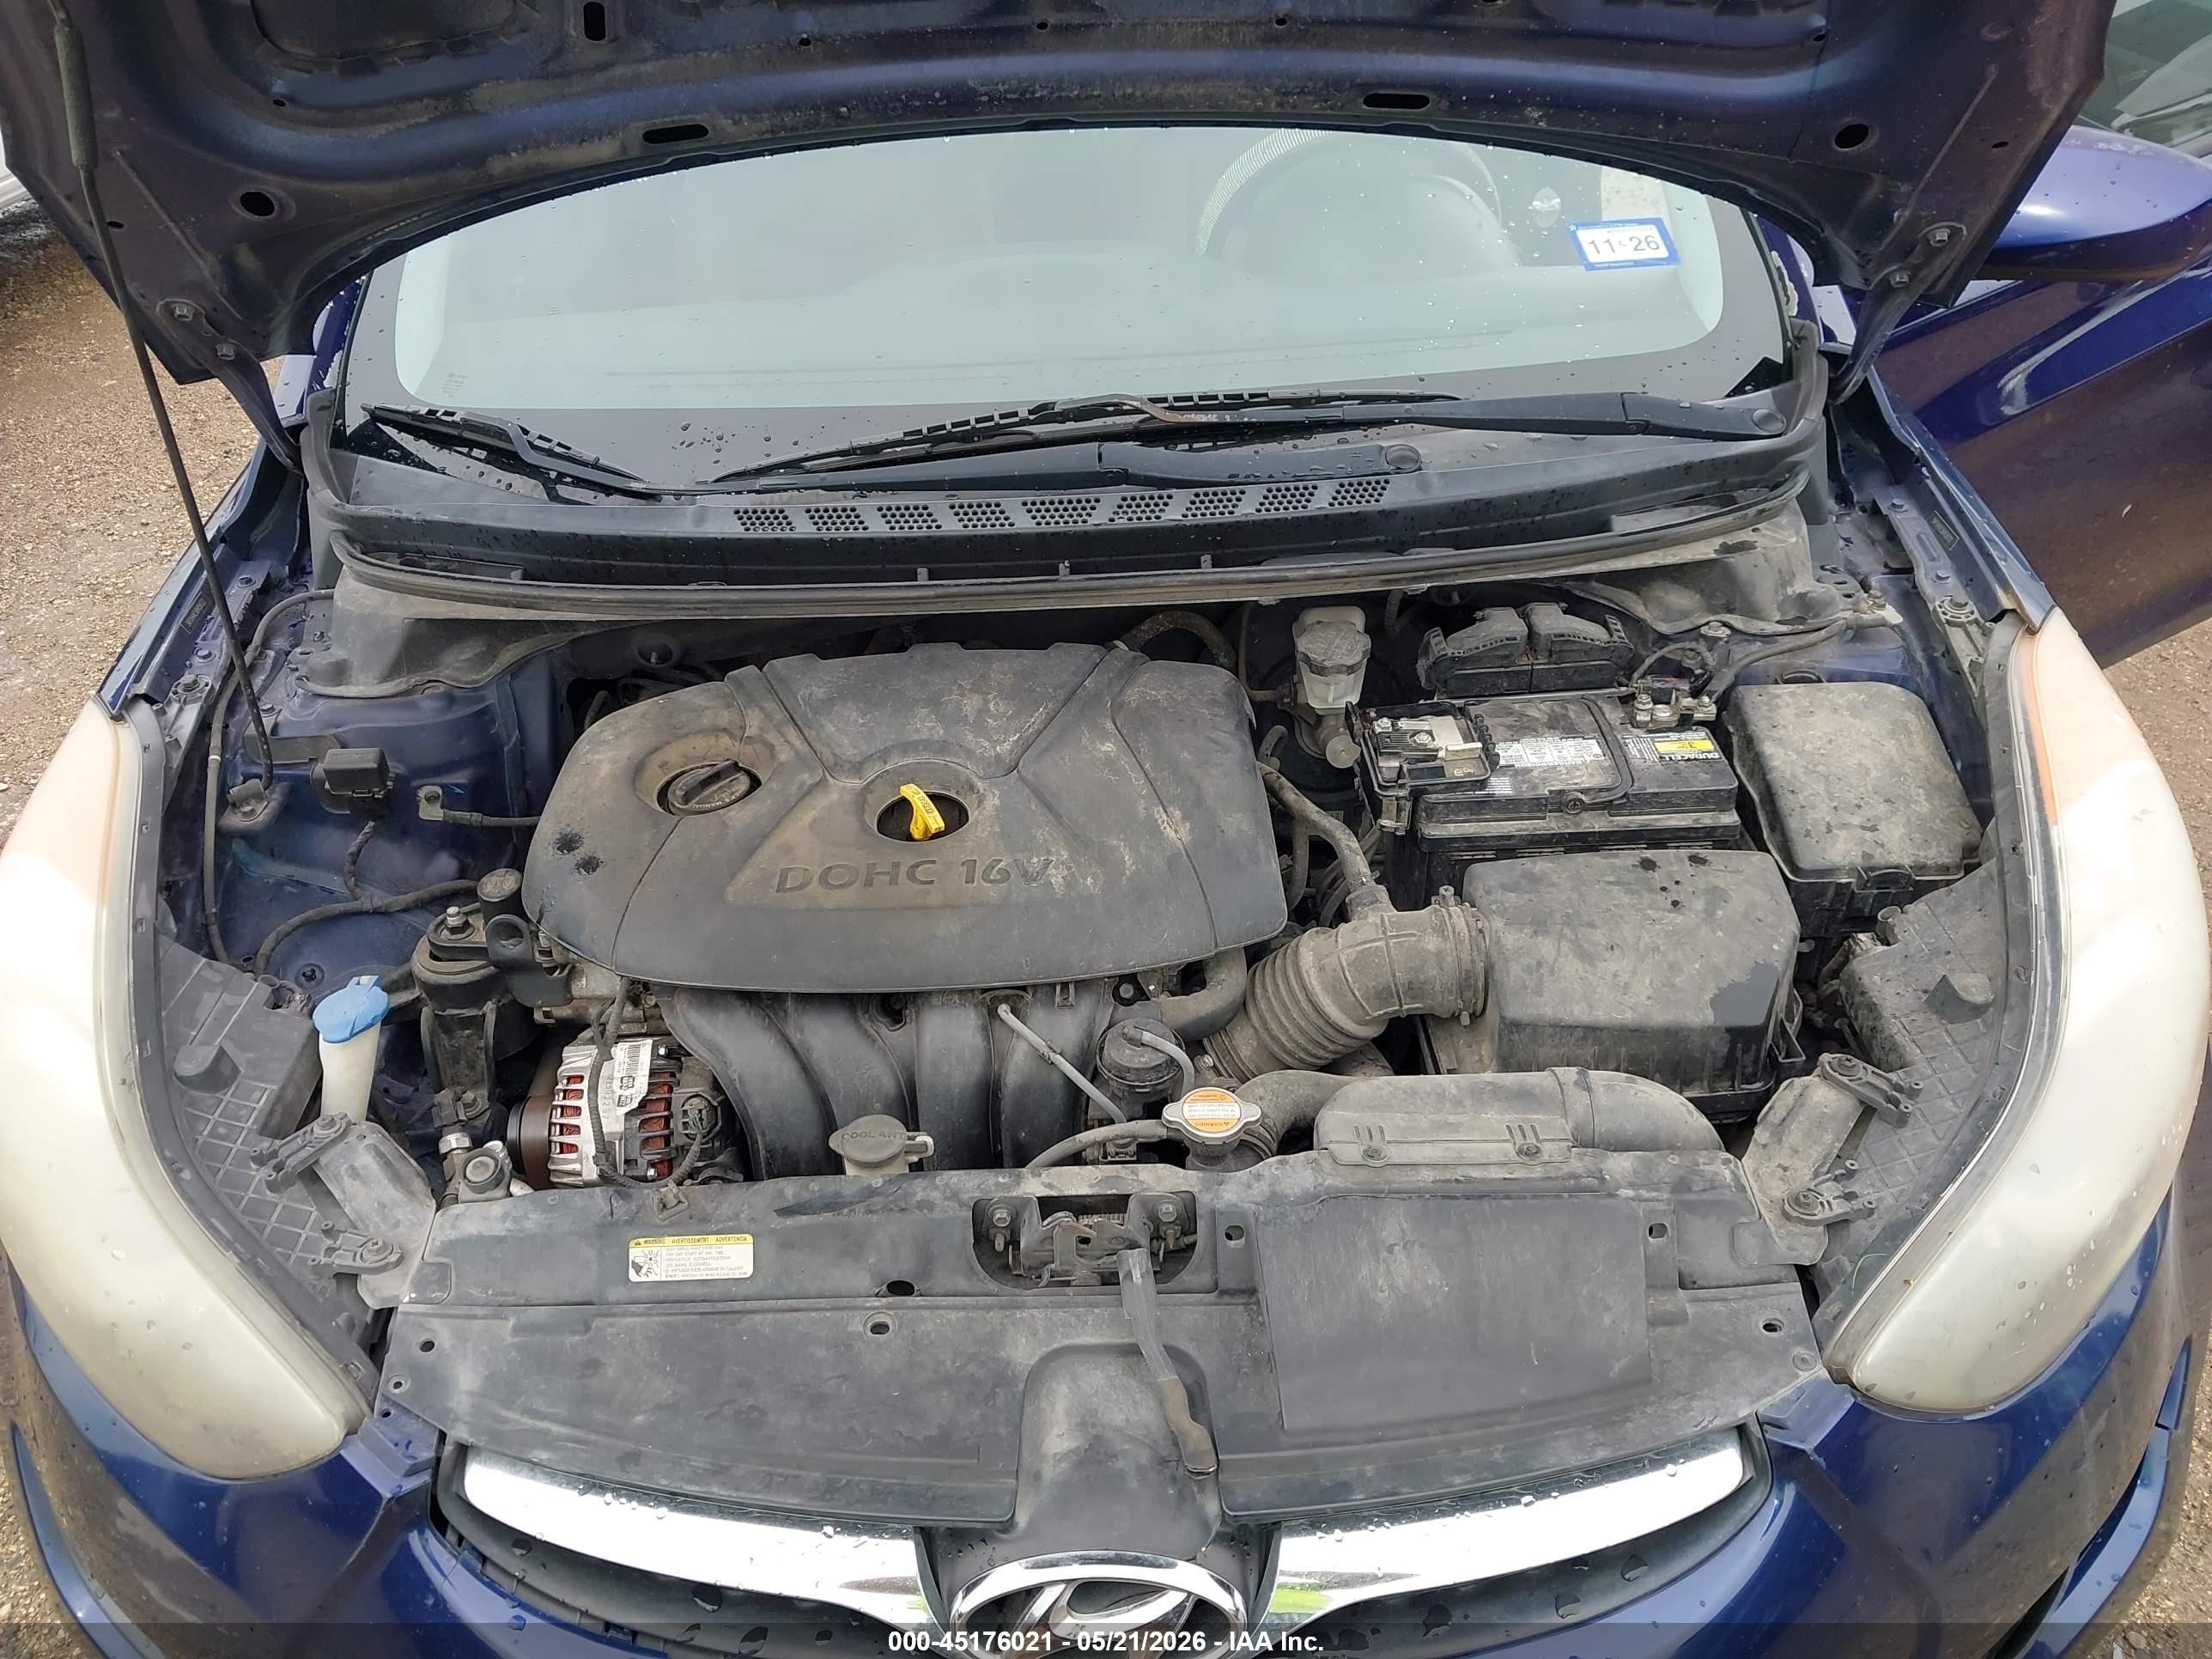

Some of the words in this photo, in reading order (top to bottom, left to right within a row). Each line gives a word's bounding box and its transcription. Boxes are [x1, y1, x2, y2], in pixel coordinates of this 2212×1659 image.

[1588, 239, 1616, 254] 11
[1629, 234, 1660, 252] 26
[1663, 752, 1720, 761] DURACELL
[775, 859, 938, 894] DOHC
[960, 858, 1054, 887] 16V
[842, 1131, 905, 1140] COOLANT
